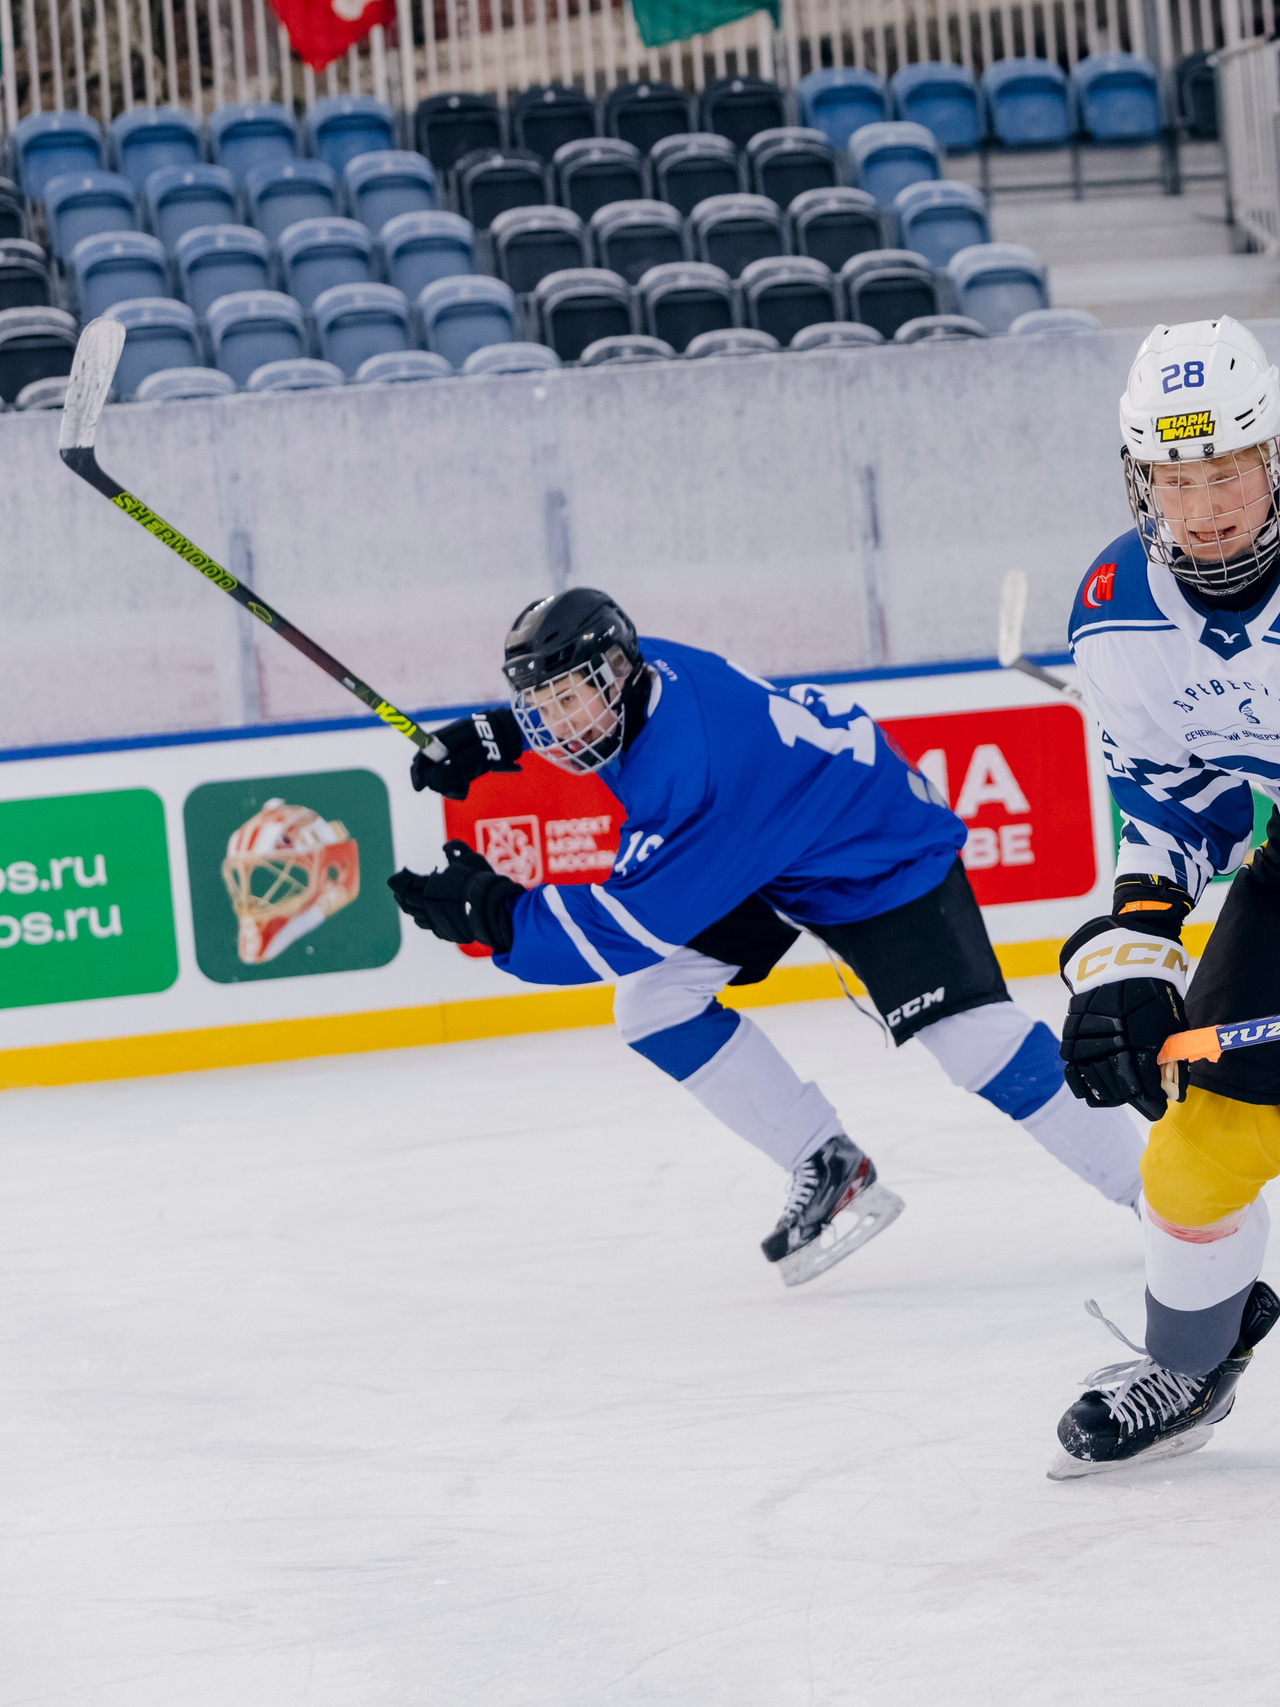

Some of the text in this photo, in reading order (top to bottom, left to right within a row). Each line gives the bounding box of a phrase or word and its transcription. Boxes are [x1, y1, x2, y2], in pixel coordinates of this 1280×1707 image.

[1161, 361, 1205, 394] 28
[1158, 412, 1210, 430] ПАРИ
[1162, 422, 1213, 440] МАТЧ
[111, 492, 237, 592] SHERWOOD
[0, 853, 108, 895] s.ru
[886, 986, 945, 1028] CCM
